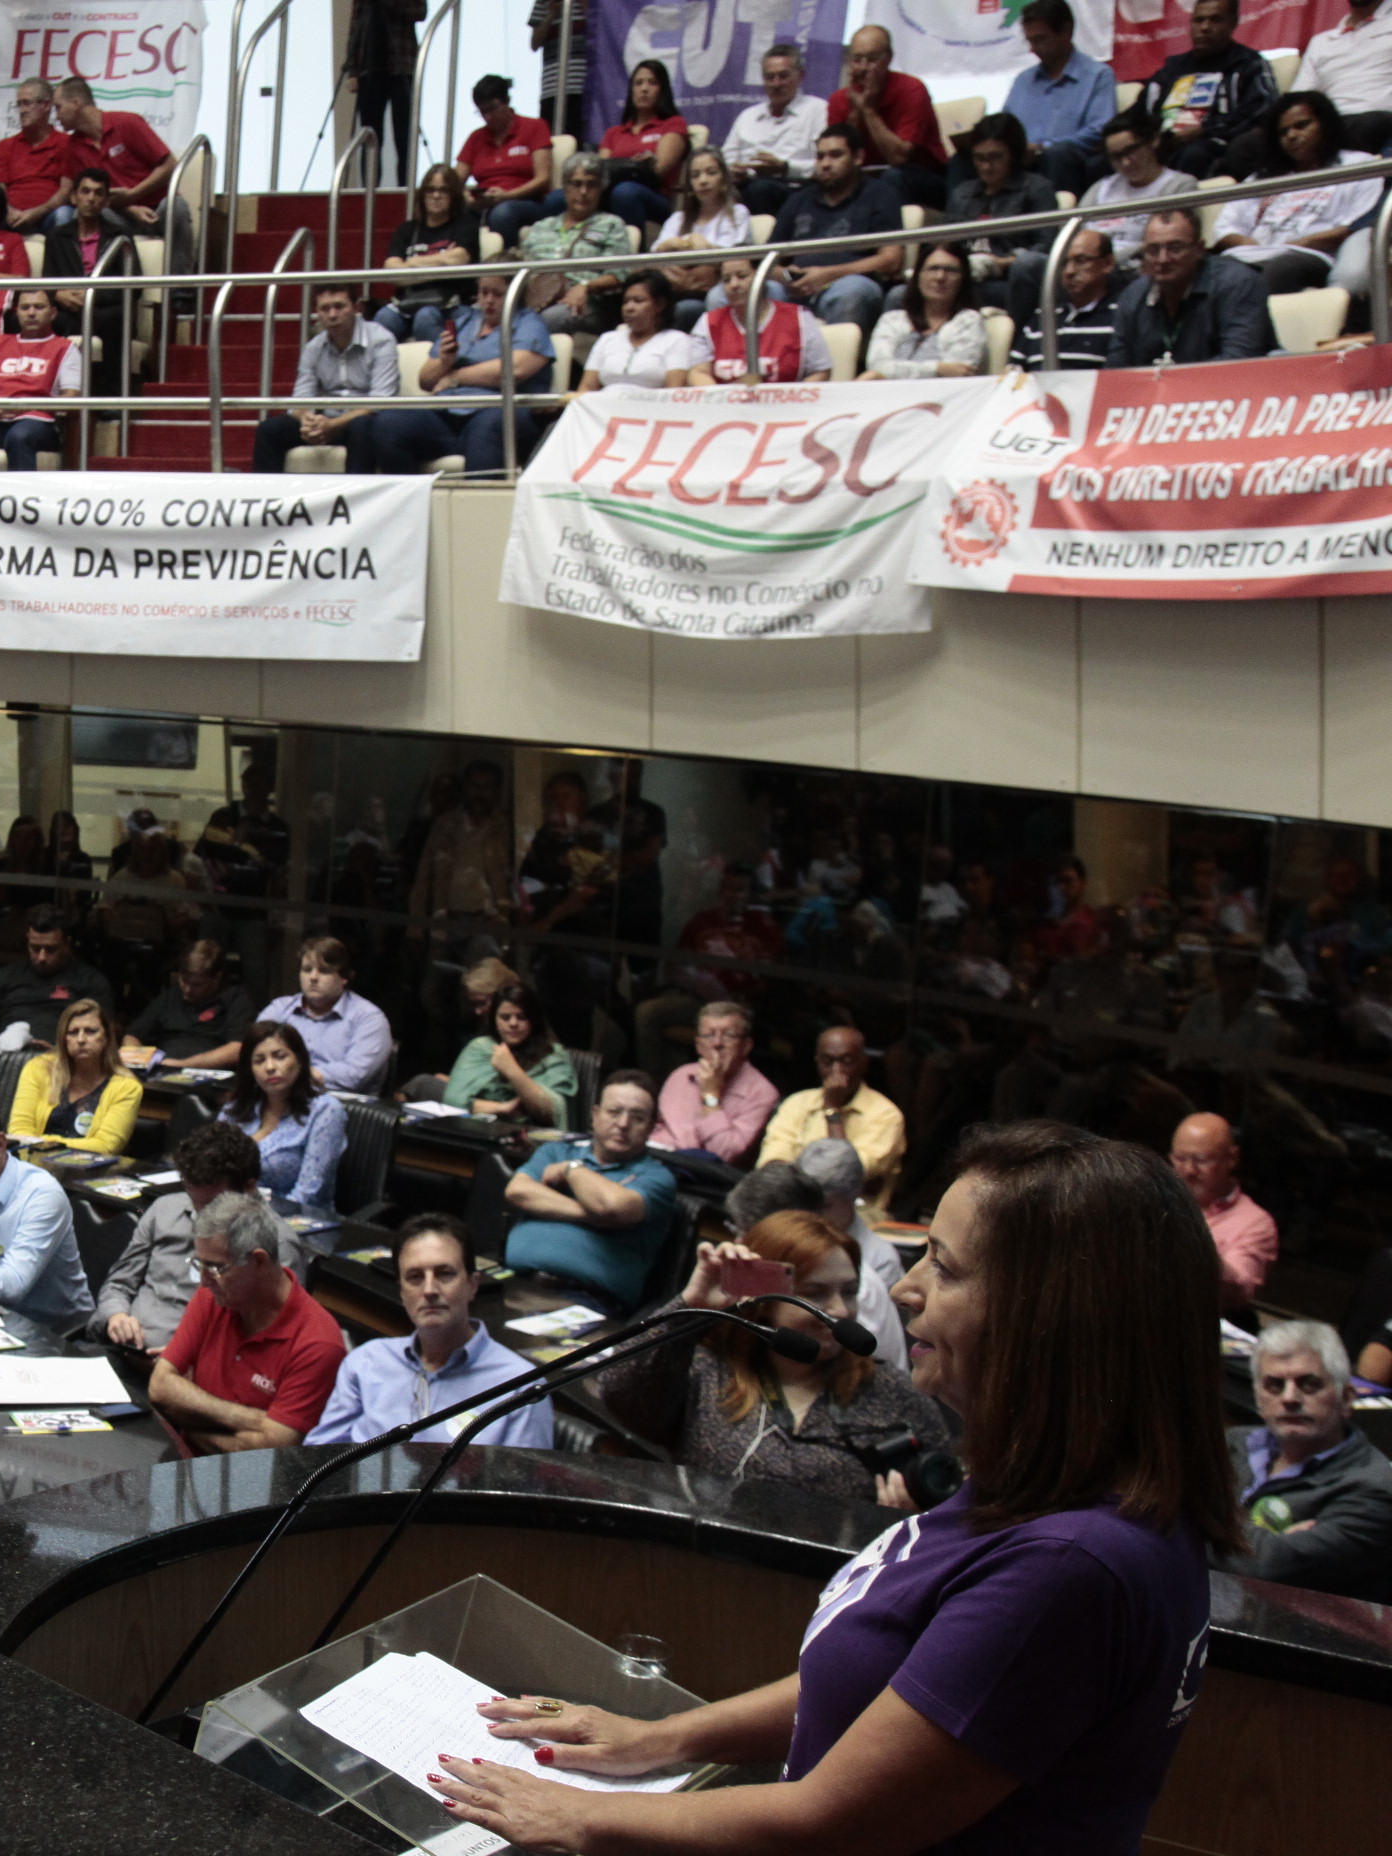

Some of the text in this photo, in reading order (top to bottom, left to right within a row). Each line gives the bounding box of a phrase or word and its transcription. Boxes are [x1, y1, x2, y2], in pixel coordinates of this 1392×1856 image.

[11, 22, 198, 80] FECESC
[624, 0, 795, 88] CUT
[990, 428, 1068, 456] UGT
[1137, 398, 1251, 445] DEFESA
[1247, 395, 1299, 440] DA
[572, 402, 944, 507] FECESC
[56, 497, 146, 528] 100%
[160, 496, 311, 529] CONTRA
[327, 494, 352, 527] A
[73, 548, 120, 580] DA
[134, 538, 378, 582] PREVIDÊNCIA
[559, 526, 707, 573] Federação dos
[1046, 541, 1166, 569] NENHUM
[1171, 538, 1285, 570] DIREITO
[1287, 538, 1310, 565] A
[550, 555, 701, 603] Trabalhadores
[709, 585, 737, 607] no
[745, 579, 851, 607] Comércio
[10, 600, 118, 616] TRABALHADORES
[121, 603, 140, 617] NO
[143, 601, 208, 619] COMÉRCIO
[211, 605, 220, 618] E
[224, 604, 289, 621] SERVIÇOS
[306, 604, 357, 620] FECESC
[544, 582, 817, 637] Estado de Santa Catarina
